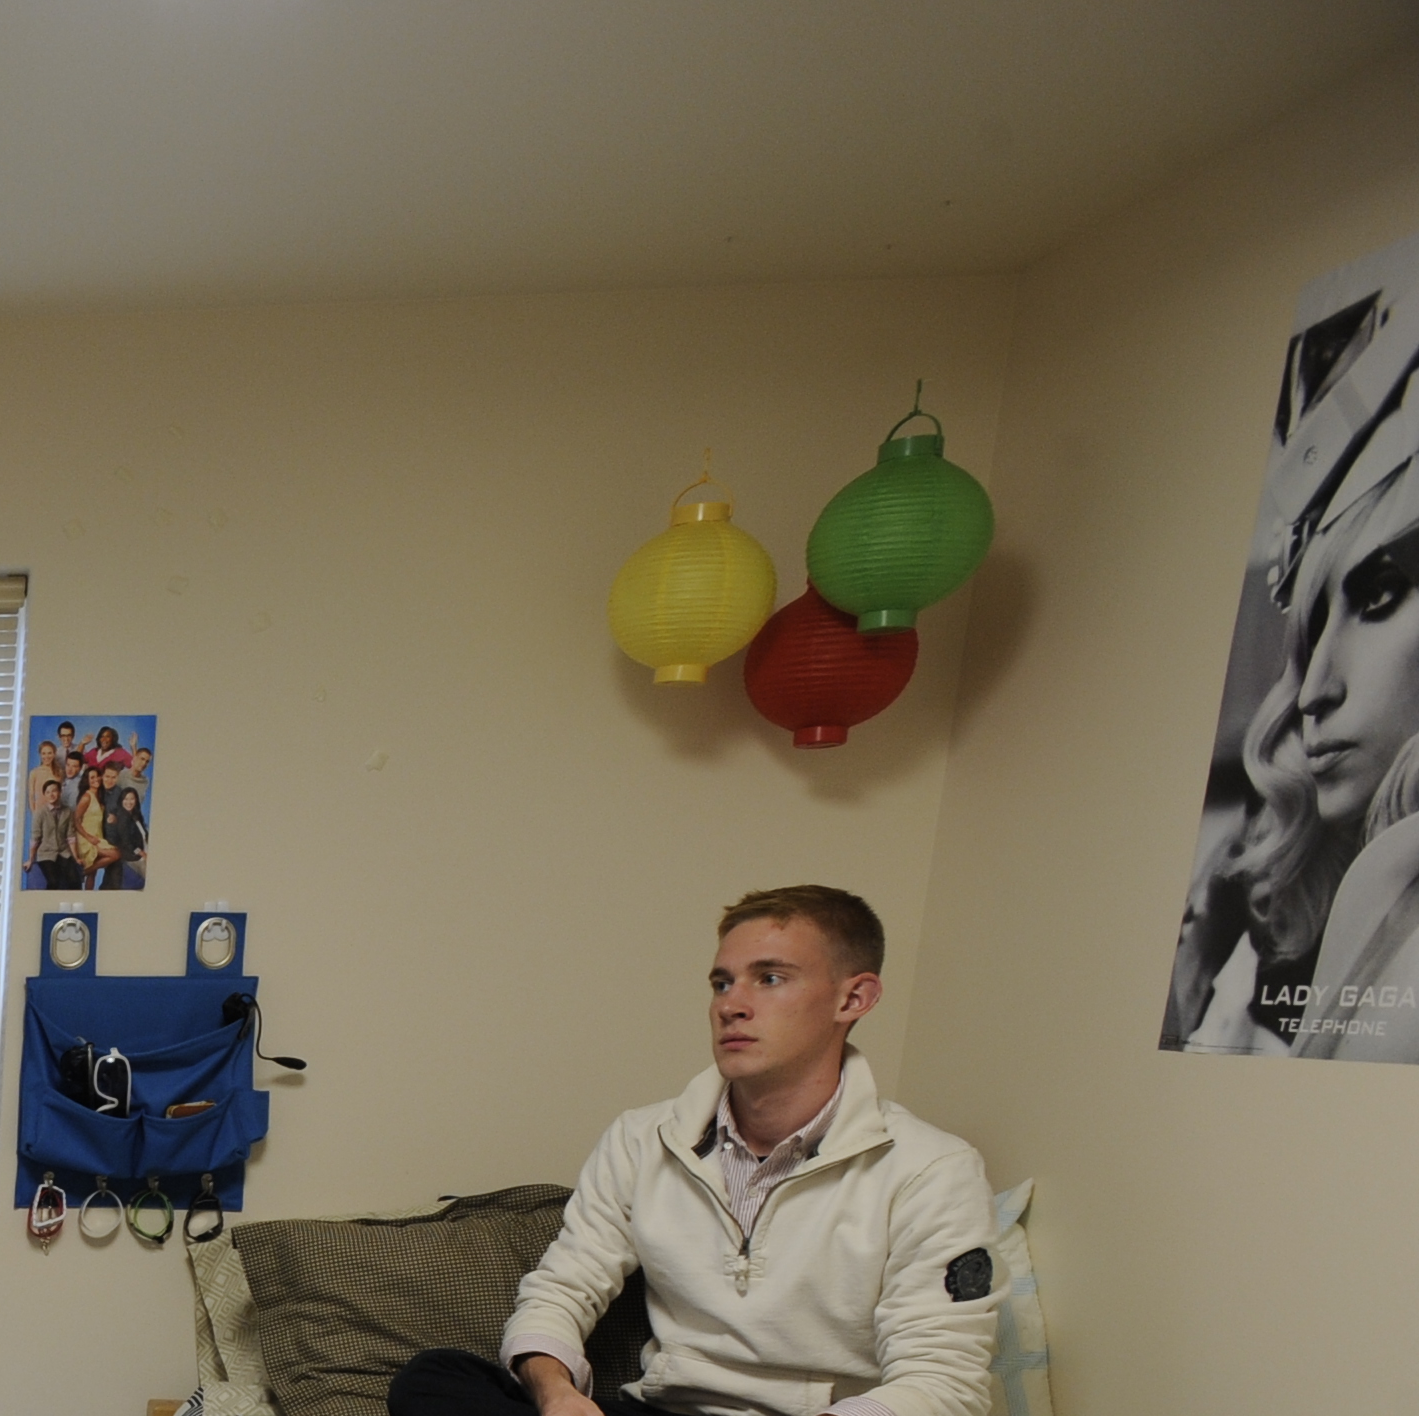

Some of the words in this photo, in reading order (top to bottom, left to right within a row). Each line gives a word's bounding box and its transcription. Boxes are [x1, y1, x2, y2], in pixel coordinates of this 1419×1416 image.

[1260, 985, 1330, 1006] LADY
[1338, 986, 1417, 1009] GAGA
[1278, 1018, 1388, 1036] TELEPHONE
